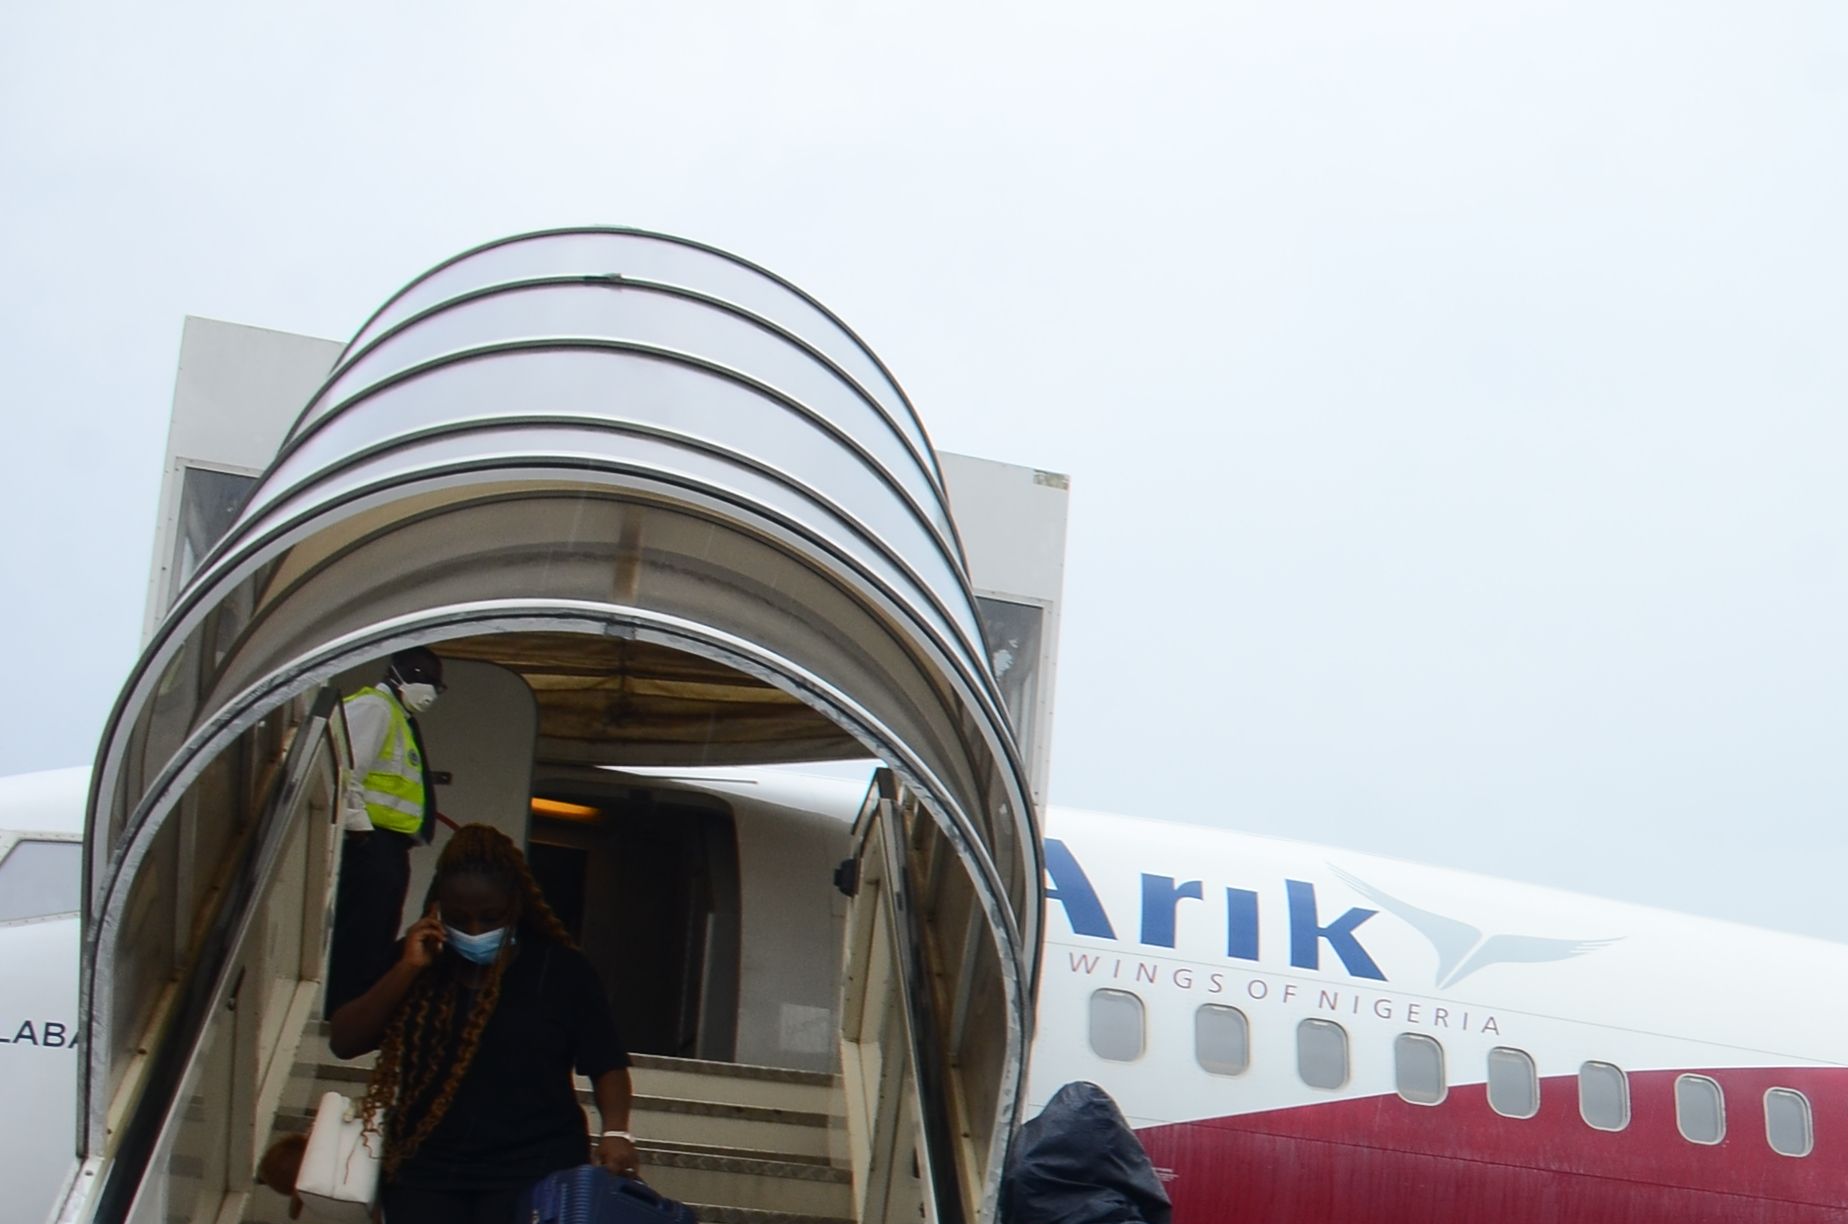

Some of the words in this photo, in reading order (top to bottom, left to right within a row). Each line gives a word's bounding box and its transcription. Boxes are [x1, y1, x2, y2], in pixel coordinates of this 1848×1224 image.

[1044, 838, 1388, 981] Arik
[1068, 951, 1224, 994] WINGS
[1248, 978, 1298, 1004] OF
[1318, 989, 1501, 1036] NIGERIA
